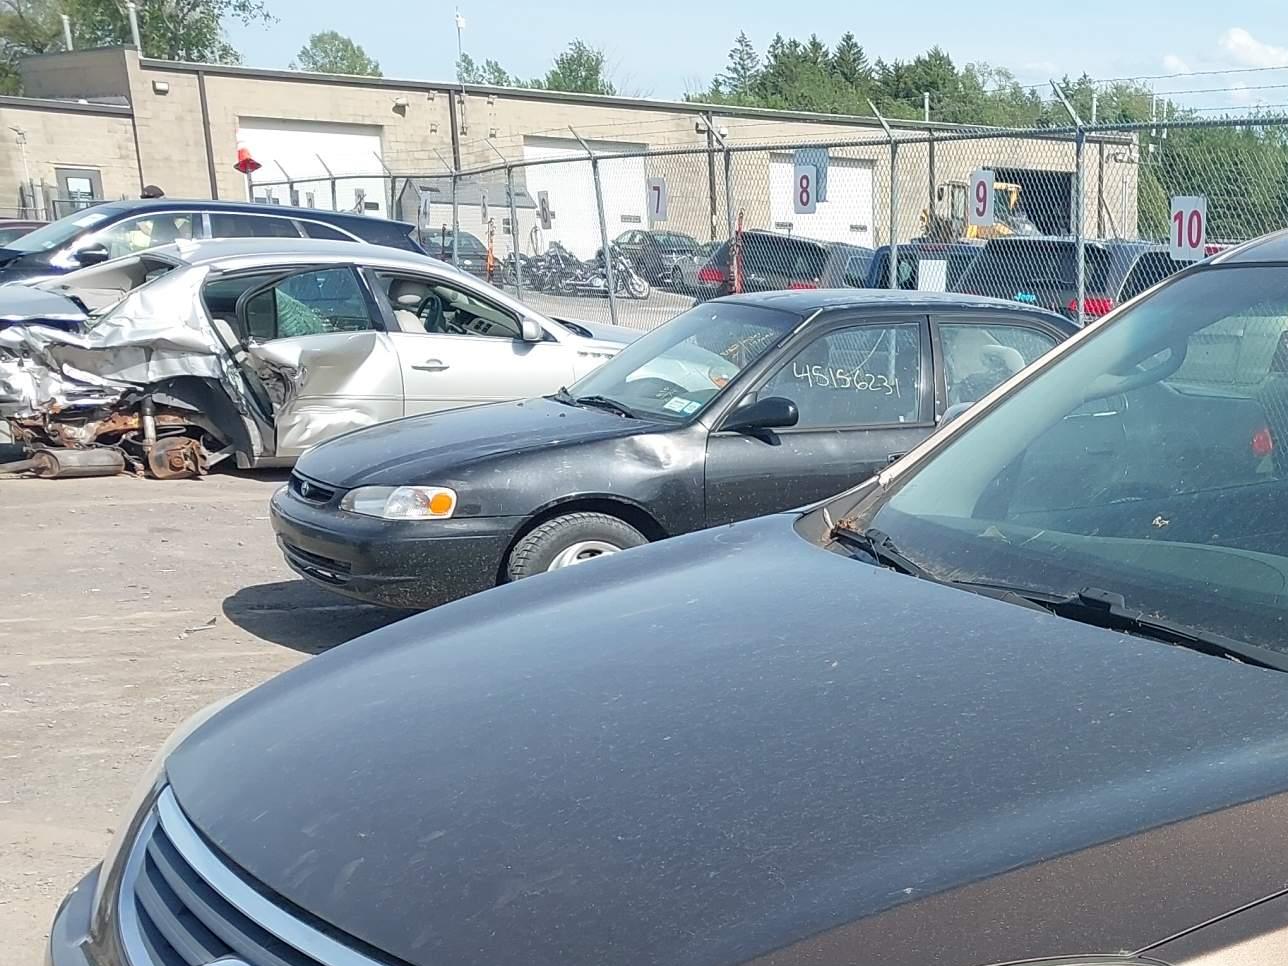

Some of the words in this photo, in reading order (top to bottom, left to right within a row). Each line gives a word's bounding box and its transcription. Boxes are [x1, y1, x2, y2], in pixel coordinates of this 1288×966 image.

[652, 185, 661, 214] 7
[799, 174, 810, 207] 8
[975, 180, 988, 217] 9
[541, 198, 549, 223] 6
[1172, 209, 1203, 249] 10
[793, 361, 901, 398] 45156231
